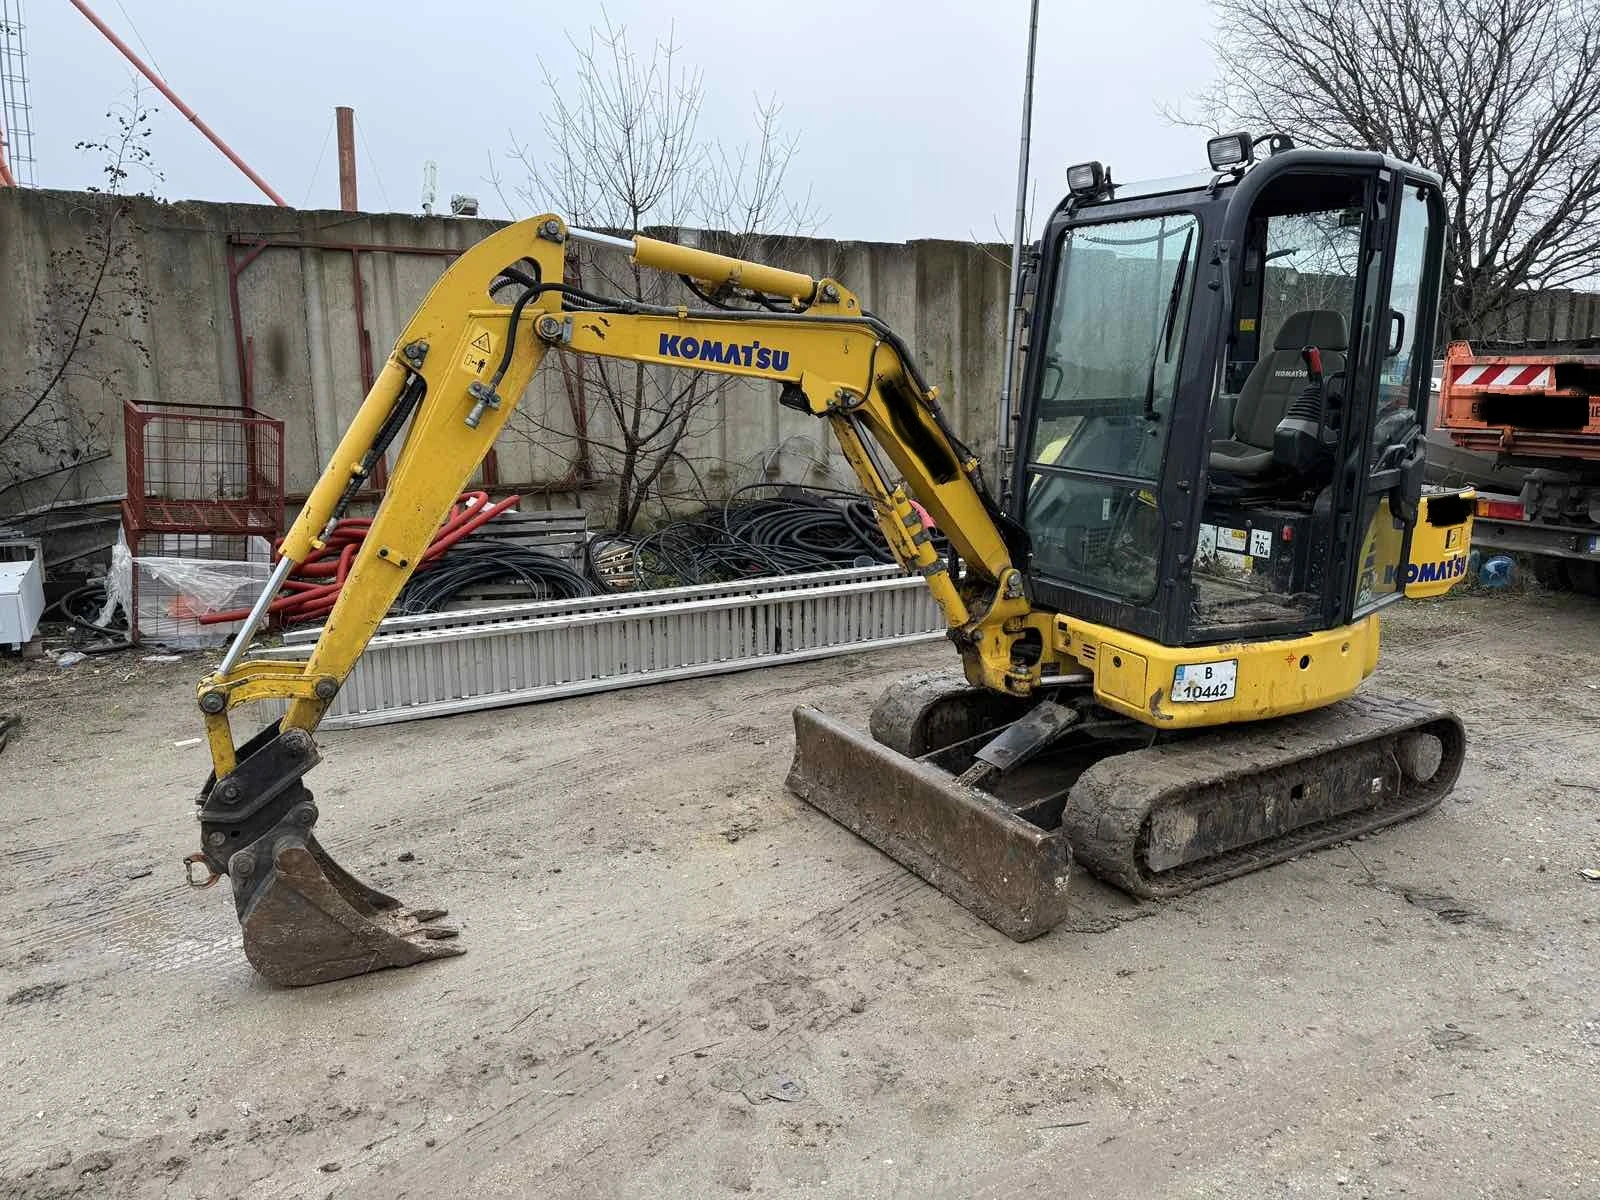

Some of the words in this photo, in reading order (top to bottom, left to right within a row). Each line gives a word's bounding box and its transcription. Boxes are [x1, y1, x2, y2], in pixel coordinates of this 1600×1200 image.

[659, 333, 790, 372] KOMATSU
[1255, 541, 1265, 555] 76
[1205, 666, 1213, 680] B
[1183, 683, 1228, 699] 10442
